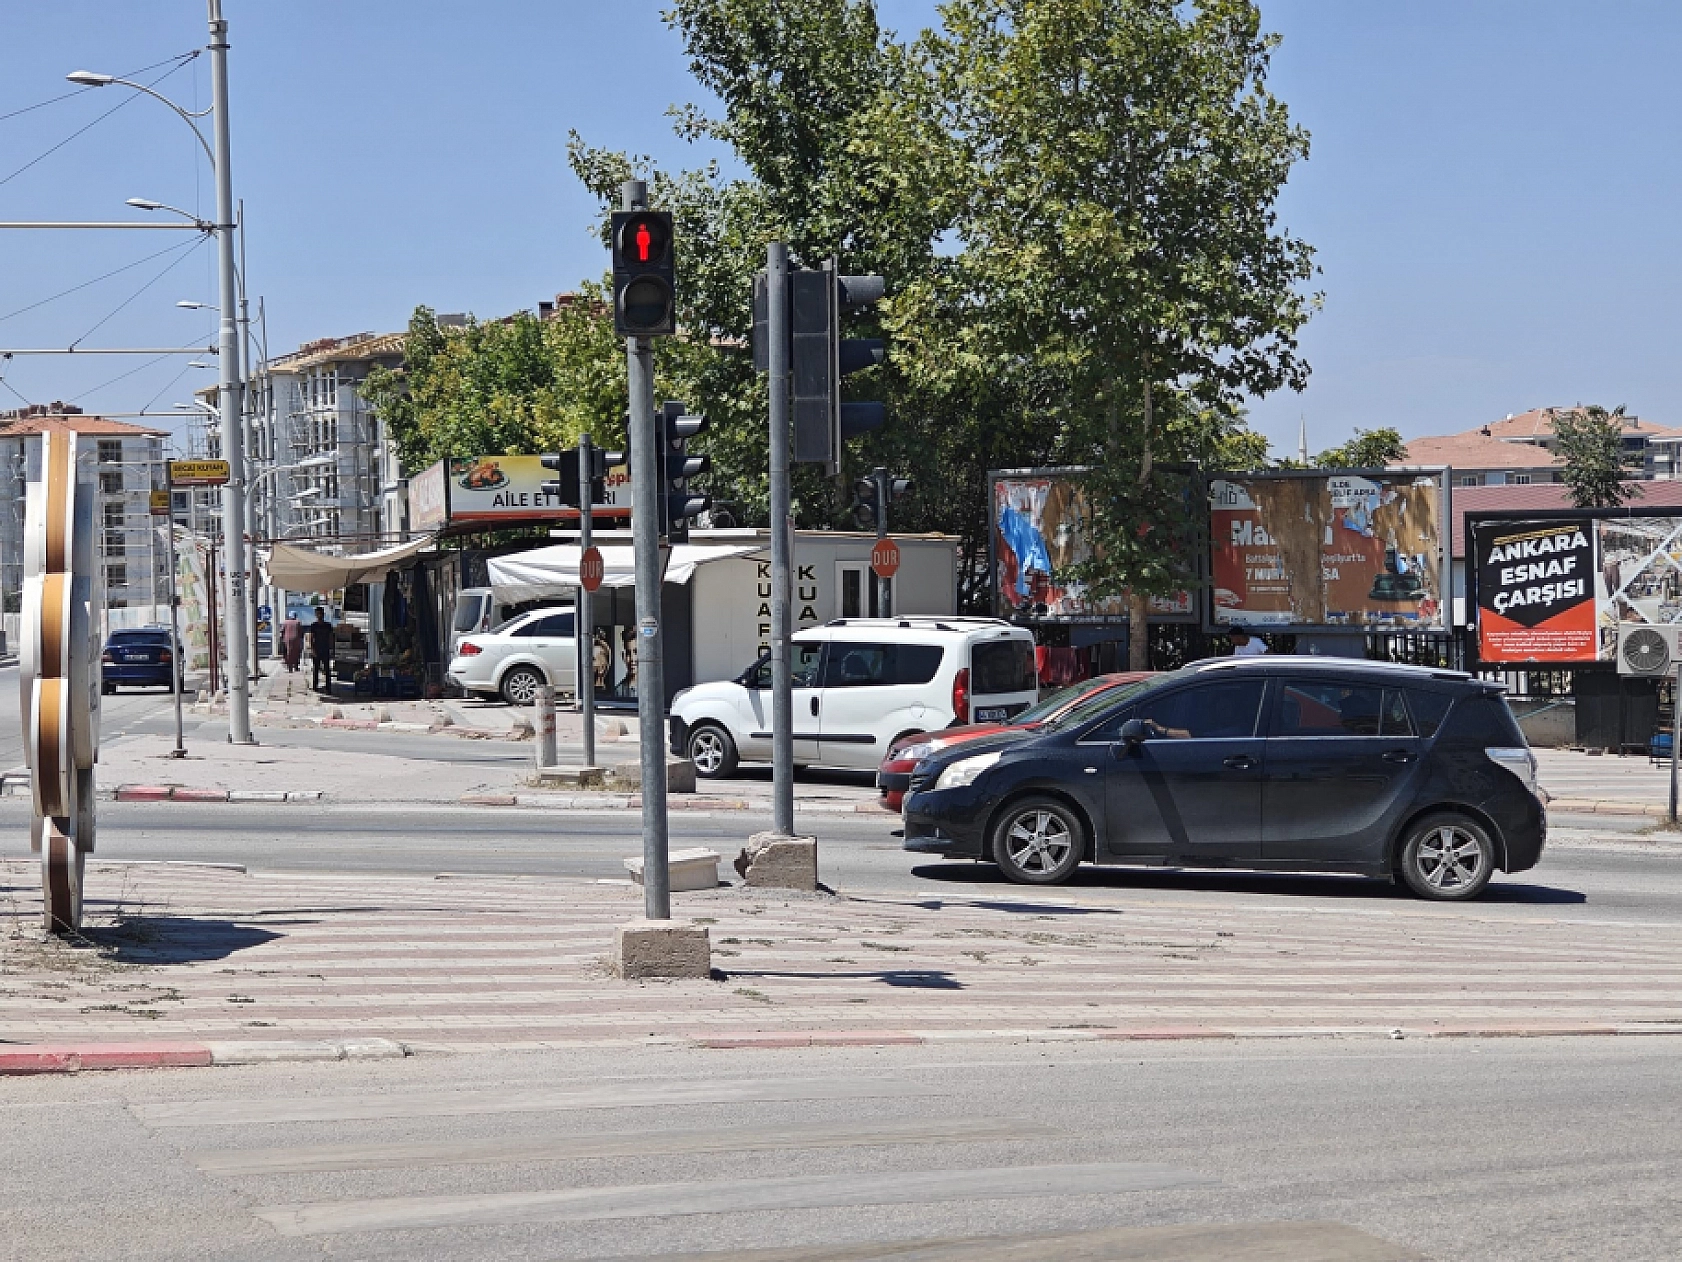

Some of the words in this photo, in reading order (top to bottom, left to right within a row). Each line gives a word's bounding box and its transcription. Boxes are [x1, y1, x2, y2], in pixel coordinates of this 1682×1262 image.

[493, 490, 528, 507] AİLE
[874, 549, 897, 566] DUR
[1487, 531, 1589, 565] ANKARA
[1501, 555, 1578, 586] ESNAF
[1493, 578, 1585, 615] ÇARŞISI
[757, 563, 772, 672] KUAFÖ
